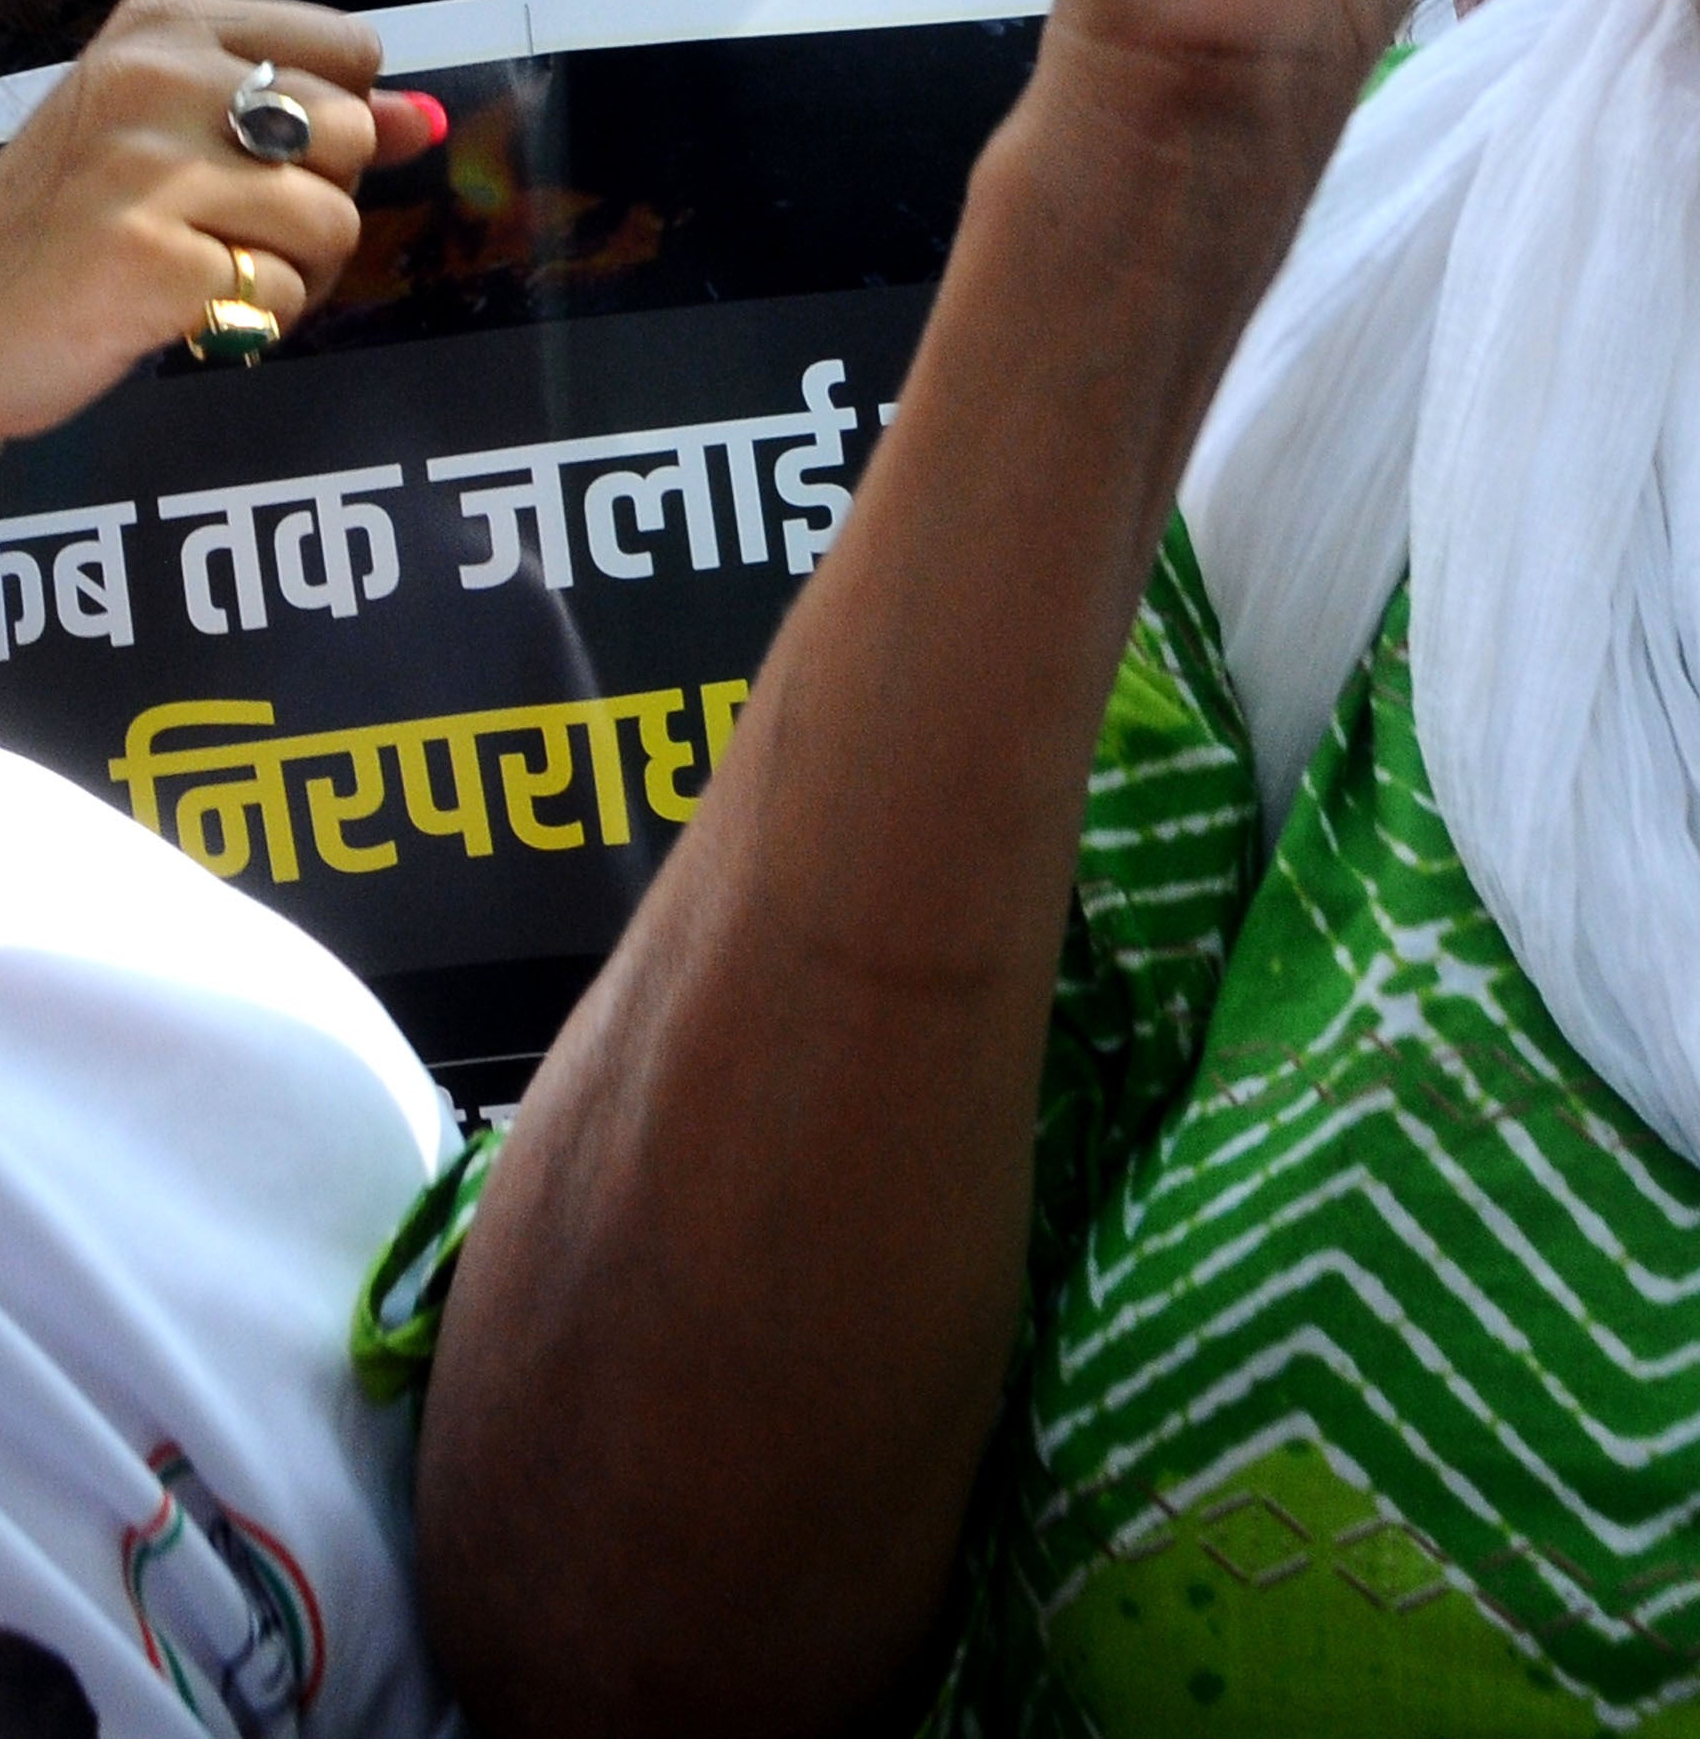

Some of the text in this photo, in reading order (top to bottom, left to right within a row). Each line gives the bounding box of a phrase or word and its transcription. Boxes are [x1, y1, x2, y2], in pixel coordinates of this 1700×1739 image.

[157, 462, 403, 634] तक
[426, 357, 859, 592] जलाई
[108, 678, 749, 884] निरपराध
